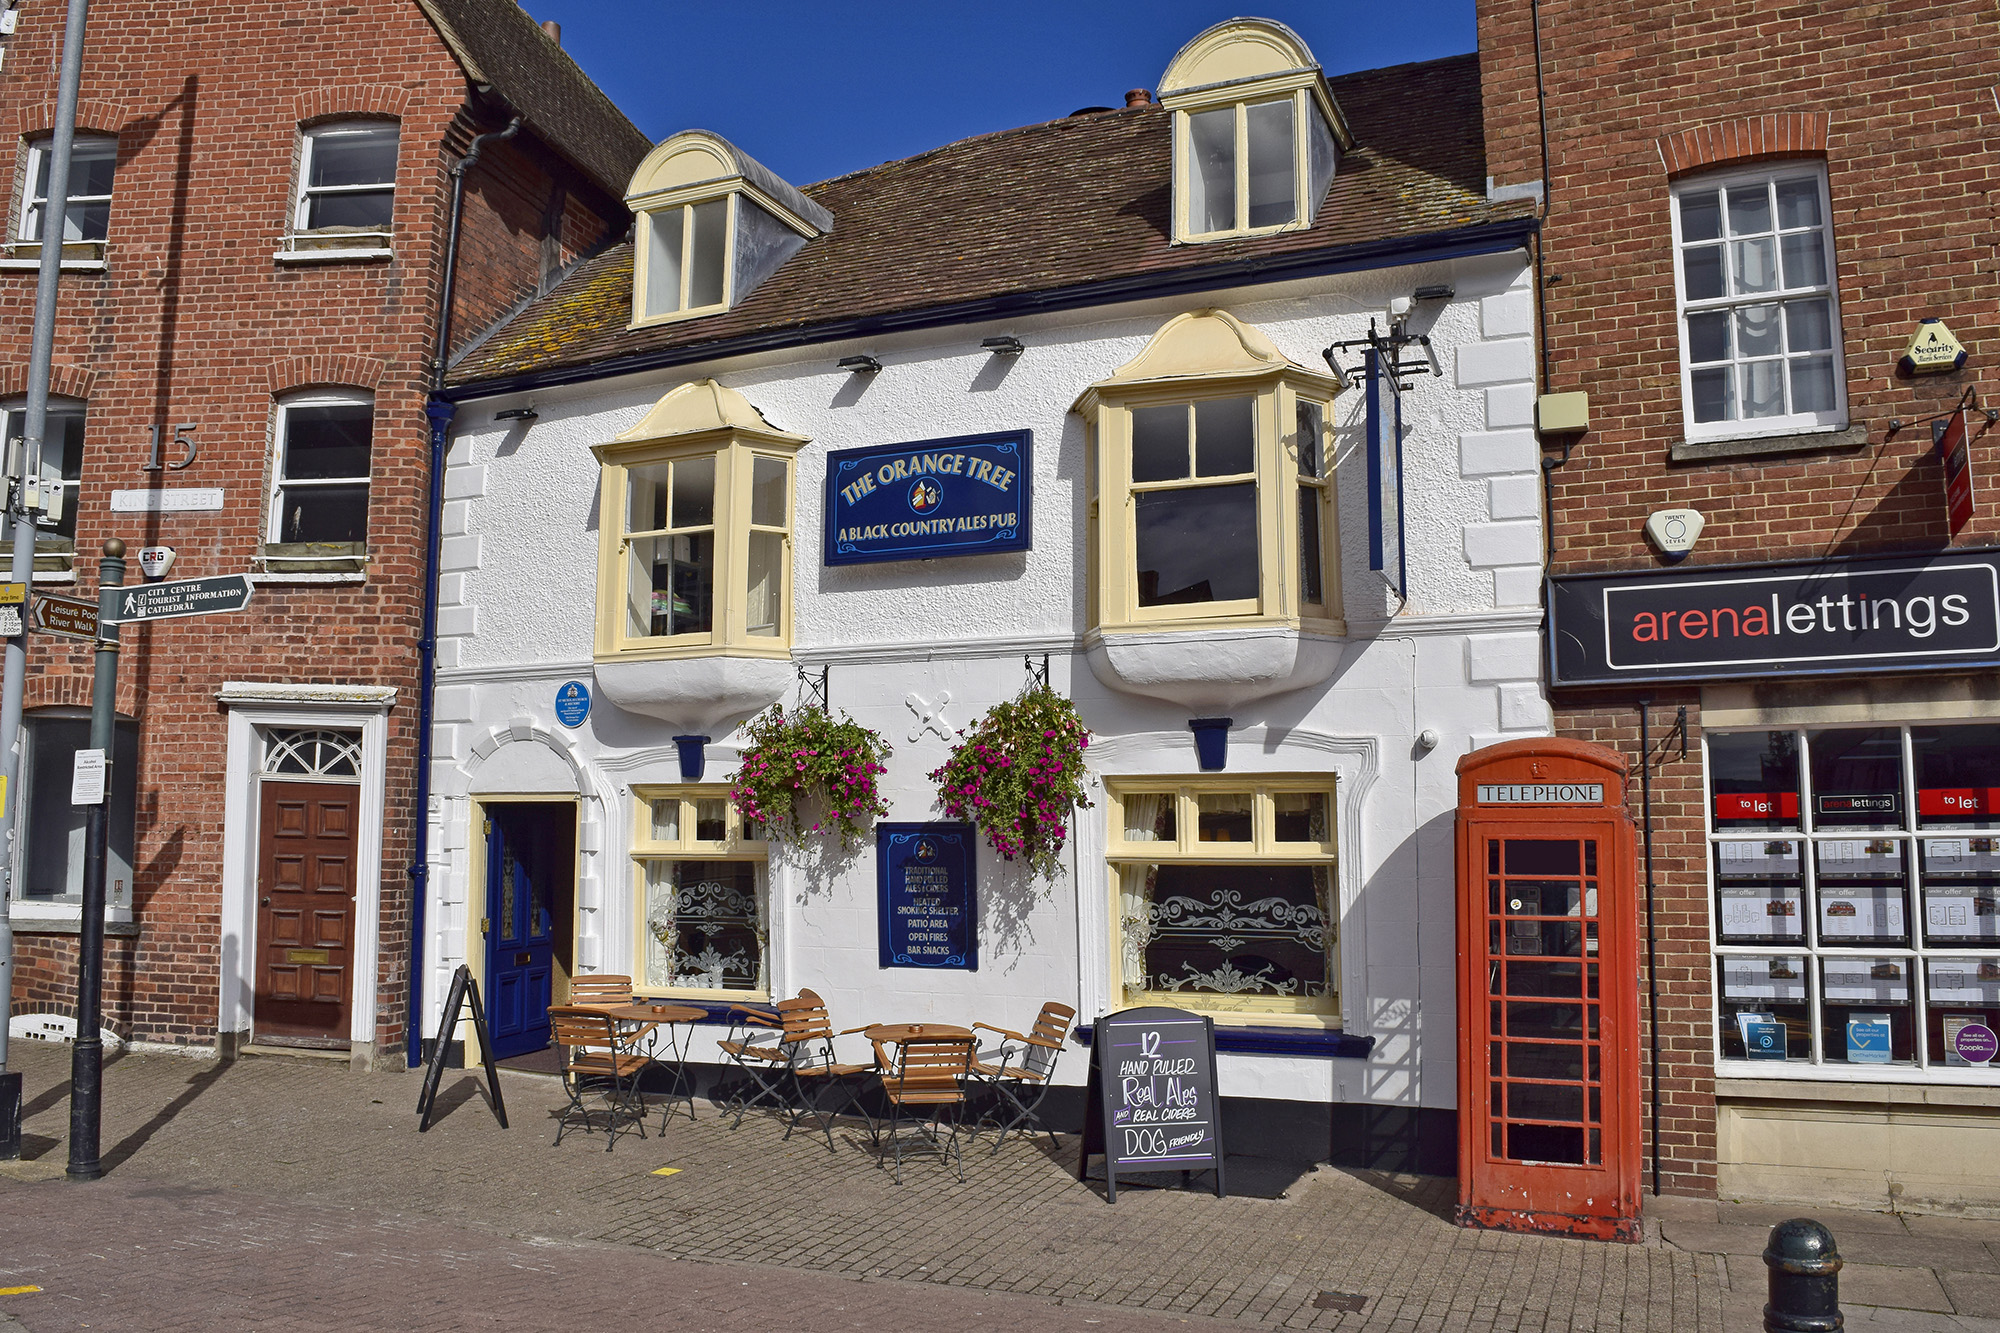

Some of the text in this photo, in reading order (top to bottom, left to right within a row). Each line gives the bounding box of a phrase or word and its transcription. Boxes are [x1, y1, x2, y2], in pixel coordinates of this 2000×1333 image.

[1914, 343, 1954, 355] Security
[143, 422, 197, 470] 15
[840, 453, 1016, 506] THE ORANGE TREE
[119, 493, 217, 507] KING STREET
[839, 512, 1017, 542] A BLACK COUNTRY ALES PUB
[143, 551, 164, 561] CRG
[148, 584, 202, 596] CITY CENTRE
[148, 588, 242, 604] TOURIST INFORMATION
[50, 603, 79, 617] Leisure
[147, 602, 195, 614] CATHEDRAL
[50, 616, 94, 632] River Walk
[1632, 593, 1970, 642] arenalettings
[1482, 785, 1599, 801] TELEPHONE
[1740, 800, 1772, 812] to let
[1943, 796, 1978, 809] to let
[904, 866, 948, 875] TRADITIONAL
[904, 875, 948, 884] HAND PULLED
[904, 885, 921, 893] ALES
[925, 885, 949, 893] CIDERS
[913, 898, 940, 906] HEATED
[897, 906, 959, 915] SMOKING SHELTER
[907, 919, 948, 928] PATIO AREA
[908, 932, 948, 942] OPEN FIRES
[907, 945, 950, 955] BAR SNACKS
[1140, 1031, 1162, 1058] 12
[1119, 1058, 1195, 1075] HAND PULLED
[1122, 1075, 1198, 1107] Real Ales
[1115, 1107, 1197, 1122] AND REAL CIDERS
[1125, 1128, 1204, 1157] DOG FRIENDLY
